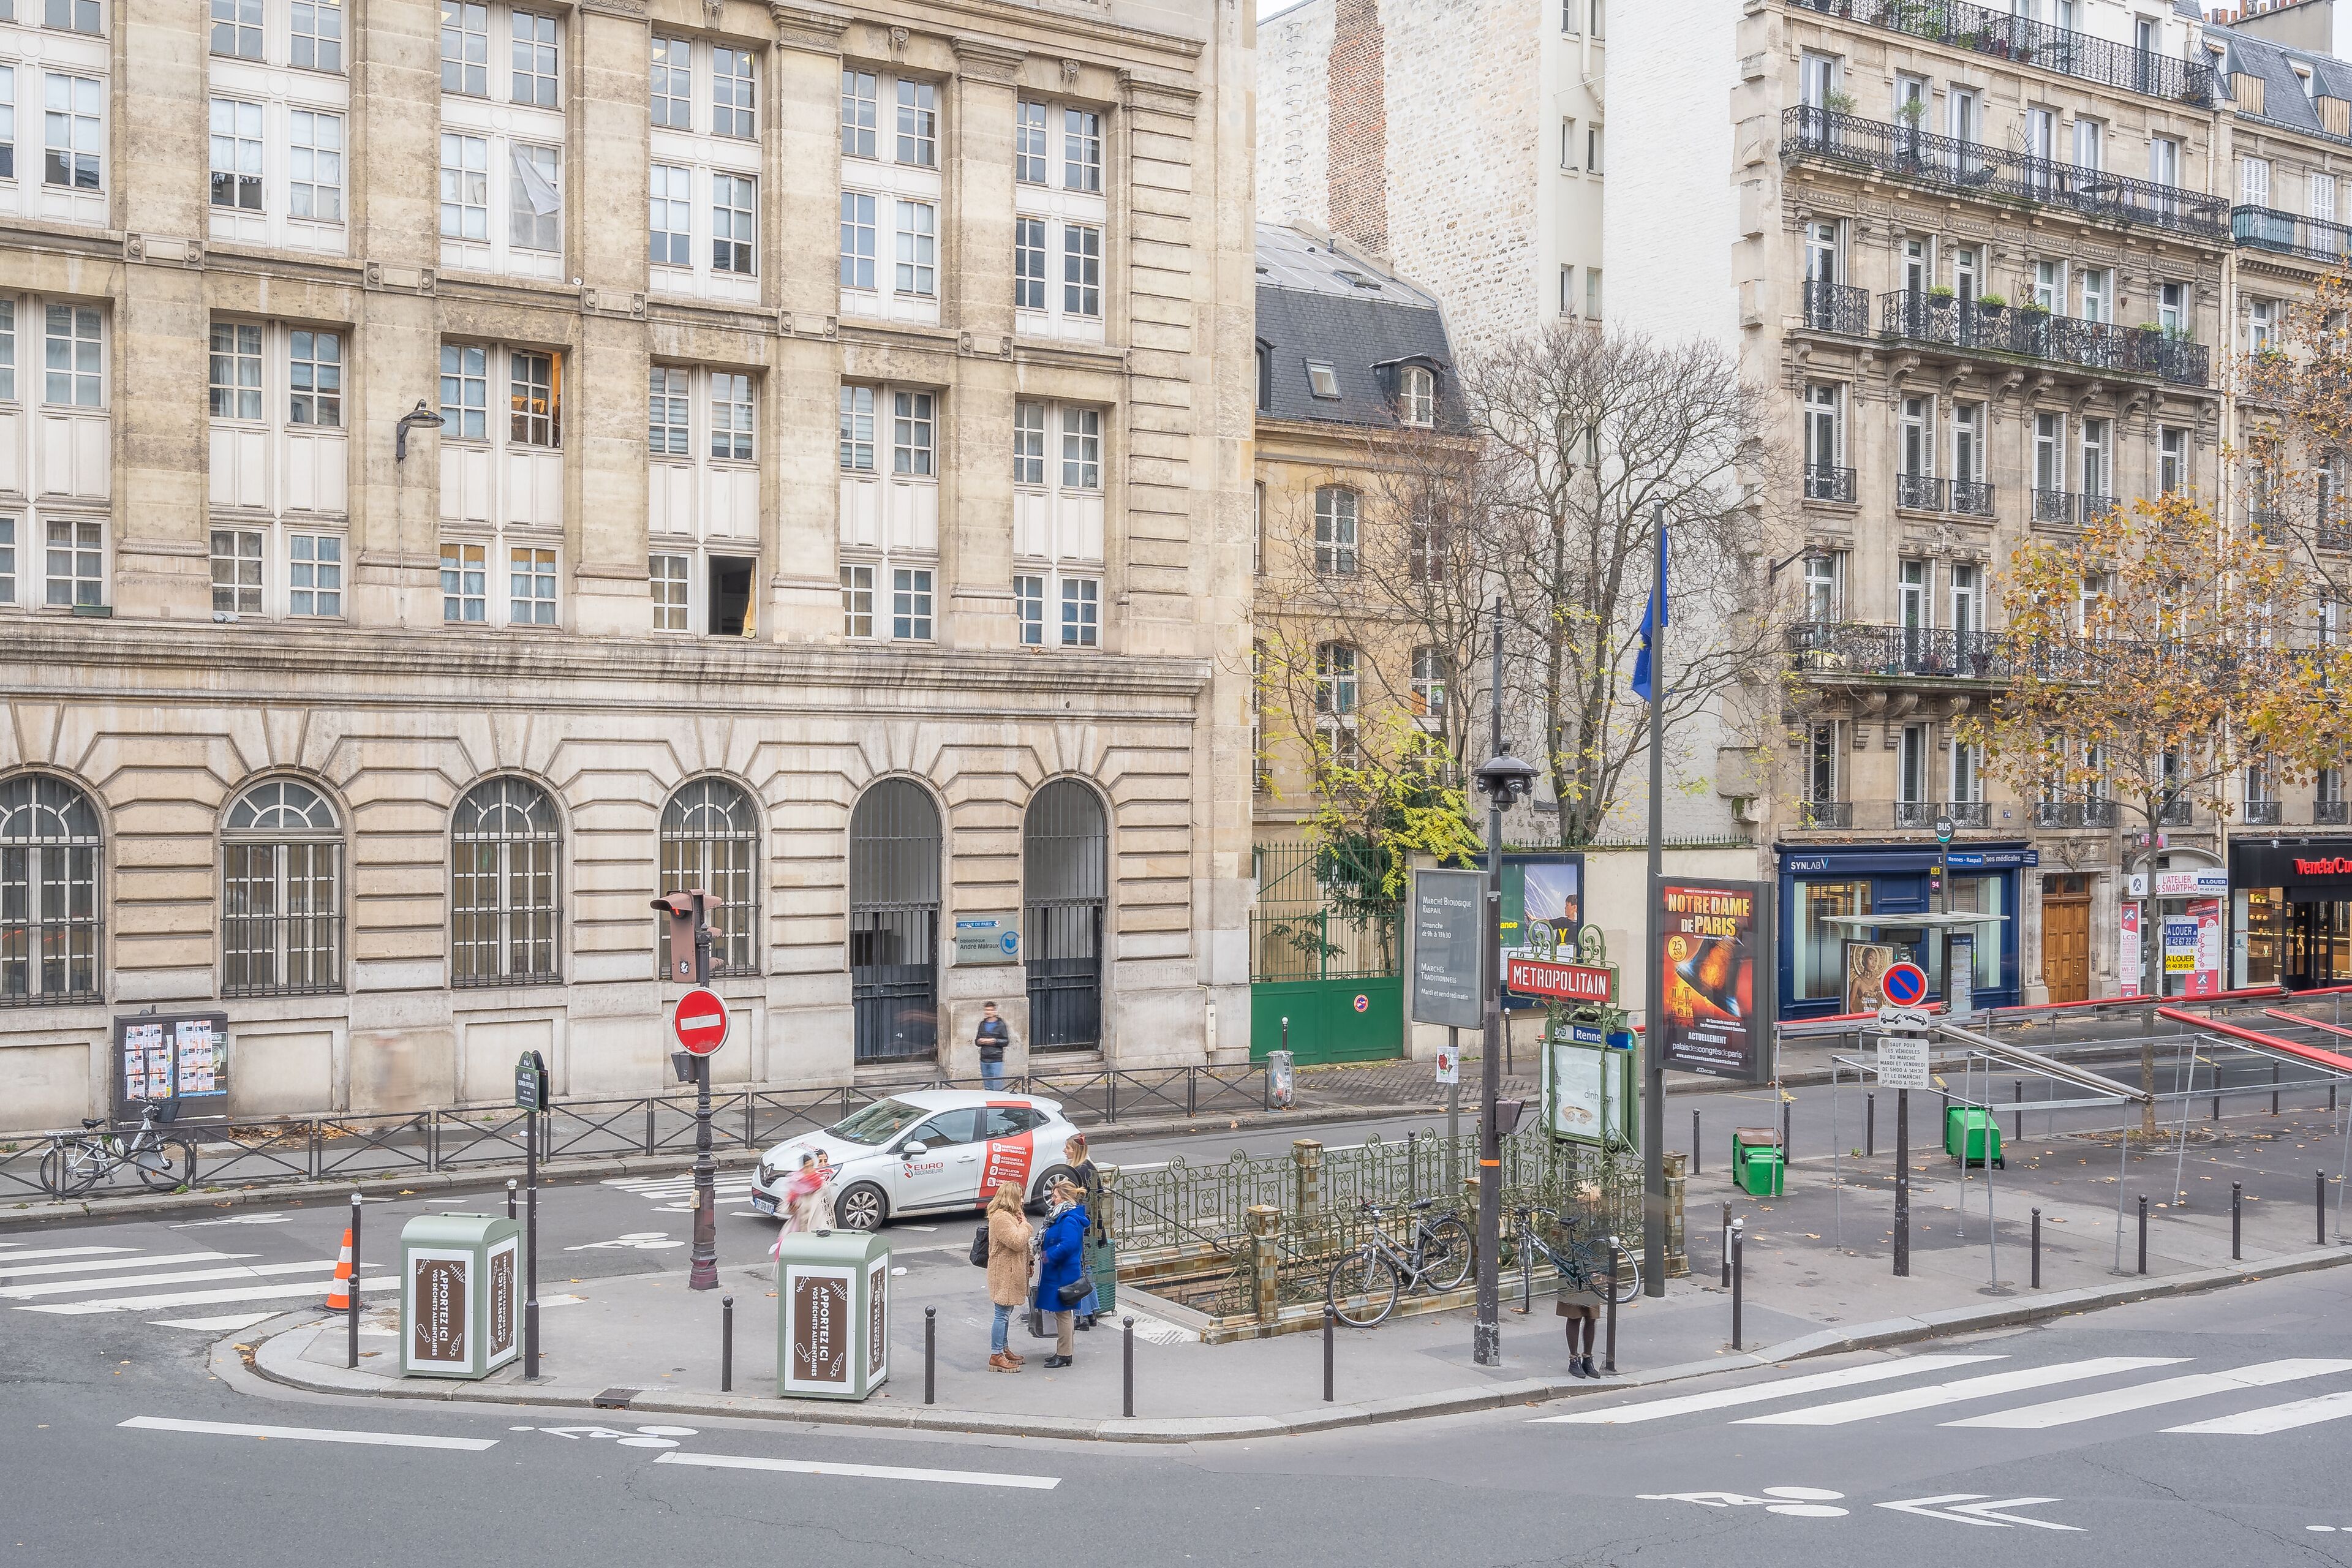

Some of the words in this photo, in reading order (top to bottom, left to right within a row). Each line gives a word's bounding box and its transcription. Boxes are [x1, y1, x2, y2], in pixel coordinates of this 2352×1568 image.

[1937, 822, 1951, 831] BUS
[1790, 861, 1821, 870] SYNLAB
[2293, 858, 2334, 875] Veneta
[2163, 875, 2191, 884] L'ATELIER
[2162, 883, 2197, 892] SMARTPHO
[1668, 893, 1710, 914] NOTRE
[1711, 896, 1750, 917] DAME
[1681, 918, 1694, 933] DE
[1694, 915, 1736, 937] PARIS
[2173, 926, 2192, 935] LOUER
[1672, 940, 1682, 951] 25
[1513, 965, 1607, 995] METROPOLITAIN
[1577, 1030, 1601, 1042] Renne
[1687, 1031, 1727, 1044] ACTUELLEMENT
[1672, 1042, 1743, 1058] palaisdescongrèsdeparis
[1584, 1088, 1599, 1100] dinh
[914, 1162, 943, 1170] EURO
[439, 1269, 448, 1324] APPORTEZ
[820, 1286, 829, 1343] APPORTEZ
[439, 1327, 448, 1341] ICI
[820, 1346, 829, 1361] ICI
